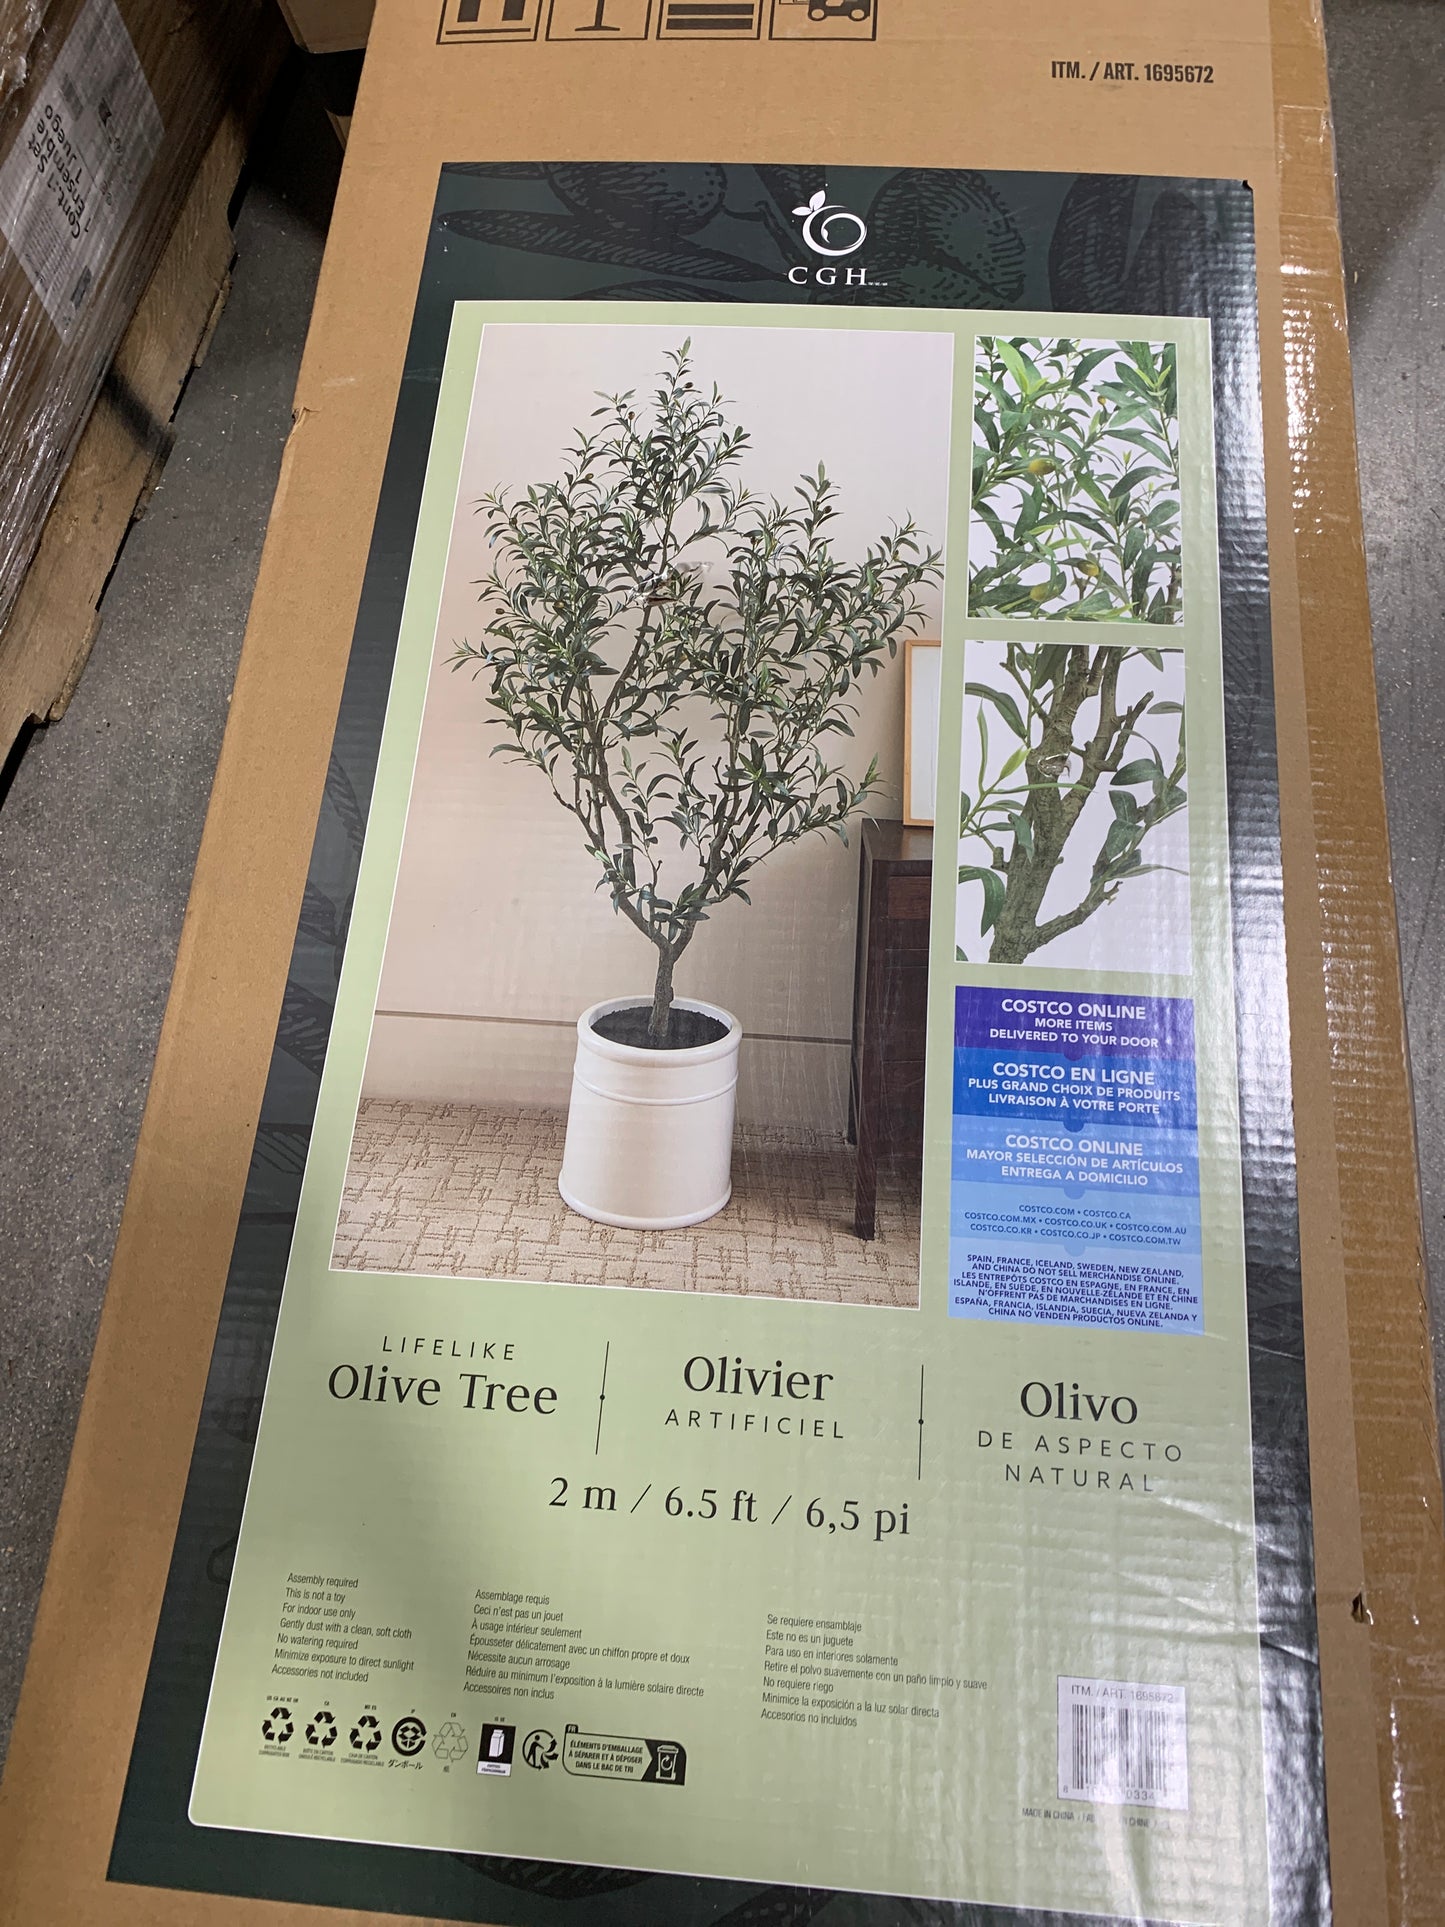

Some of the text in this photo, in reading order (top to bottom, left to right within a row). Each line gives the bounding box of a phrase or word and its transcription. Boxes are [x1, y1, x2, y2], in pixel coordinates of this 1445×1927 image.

[1051, 61, 1214, 83] ITM. / ART. 1695672
[28, 133, 48, 173] Set
[45, 105, 82, 184] 1 Juego
[37, 118, 85, 217] Ensemble
[84, 218, 91, 233] 1
[788, 266, 867, 286] CGH
[1001, 999, 1146, 1019] COSTCO ONLINE
[1035, 1017, 1113, 1031] MORE ITEMS
[990, 1028, 1158, 1048] DELIVERED TO YOUR DOOR
[993, 1062, 1155, 1085] COSTCO EN LIGNE
[968, 1078, 1181, 1101] PLUS GRAND CHOIX DE PRODUITS
[989, 1093, 1160, 1115] LIVRAISON À VOTRE PORTE
[1005, 1134, 1143, 1156] COSTCO ONLINE
[967, 1149, 1183, 1173] MAYOR SELECCIÓN DE ARTÍCULOS
[1002, 1165, 1148, 1186] ENTREGA A DOMICILIO
[1019, 1204, 1131, 1219] COSTCO.COM COSTCO.CA
[964, 1212, 1187, 1235] COSTCO.COM.MX COSTCO.CO.UK COSTCO.COM.AU
[970, 1223, 1181, 1245] COSTCO.CO.KR COSTCO.CO.JP COSTCO.COM.TW
[967, 1254, 1184, 1278] SPAIN, FRANCE, ICELAND, SWEDEN, NEW ZEALAND,
[972, 1262, 1179, 1285] AND CHINA DO NOT SELL MERCHANDISE ONLINE.
[953, 1278, 992, 1290] ISLANDE,
[994, 1281, 1007, 1290] EN
[1041, 1285, 1053, 1293] EN
[1055, 1283, 1143, 1300] NOUVELLE-ZÉLANDE
[1145, 1293, 1155, 1301] ET
[1157, 1294, 1169, 1302] EN
[1171, 1294, 1198, 1304] CHINE
[962, 1271, 976, 1280] LES
[1029, 1276, 1064, 1286] COSTCO
[1066, 1279, 1078, 1287] EN
[1080, 1280, 1122, 1291] ESPAGNE,
[1124, 1283, 1136, 1291] EN
[1138, 1284, 1175, 1295] FRANCE,
[1178, 1287, 1190, 1295] EN
[955, 1296, 991, 1307] ESPAÑA,
[993, 1299, 1034, 1311] FRANCIA,
[1036, 1303, 1079, 1314] ISLANDIA,
[1081, 1306, 1115, 1317] SUECIA,
[1116, 1309, 1147, 1318] NUEVA
[1149, 1311, 1189, 1321] ZELANDA
[1028, 1292, 1044, 1301] PAS
[1046, 1293, 1058, 1302] DE
[1060, 1295, 1128, 1307] MARCHANDISES
[1131, 1300, 1143, 1308] EN
[1145, 1301, 1173, 1310] LIGNE.
[988, 1307, 1163, 1327] CHINA NO VENDEN PRODUCTOS ONLINE.
[382, 1336, 515, 1361] LIFELIKE
[329, 1364, 557, 1415] Olive Tree
[684, 1356, 834, 1401] Olivier
[1020, 1382, 1137, 1424] Olivo
[664, 1409, 843, 1439] ARTIFICIEL
[978, 1430, 1181, 1462] DE ASPECTO
[1006, 1464, 1152, 1492] NATURAL
[549, 1477, 910, 1542] 2 m / 6.5 ft / 6,5 pi
[287, 1572, 359, 1588] Assembly required
[286, 1587, 346, 1605] This is not a toy
[475, 1589, 550, 1606] Assemblage requis
[282, 1602, 356, 1621] For indoor use only
[280, 1617, 412, 1639] Gently dust with a clean, soft cloth
[767, 1613, 862, 1634] Se requiere ensamblaje
[277, 1632, 359, 1650] No watering required
[274, 1648, 414, 1672] Minimize exposure to direct sunlight
[271, 1663, 369, 1683] Accessories not included
[388, 1759, 424, 1770] ダンボール
